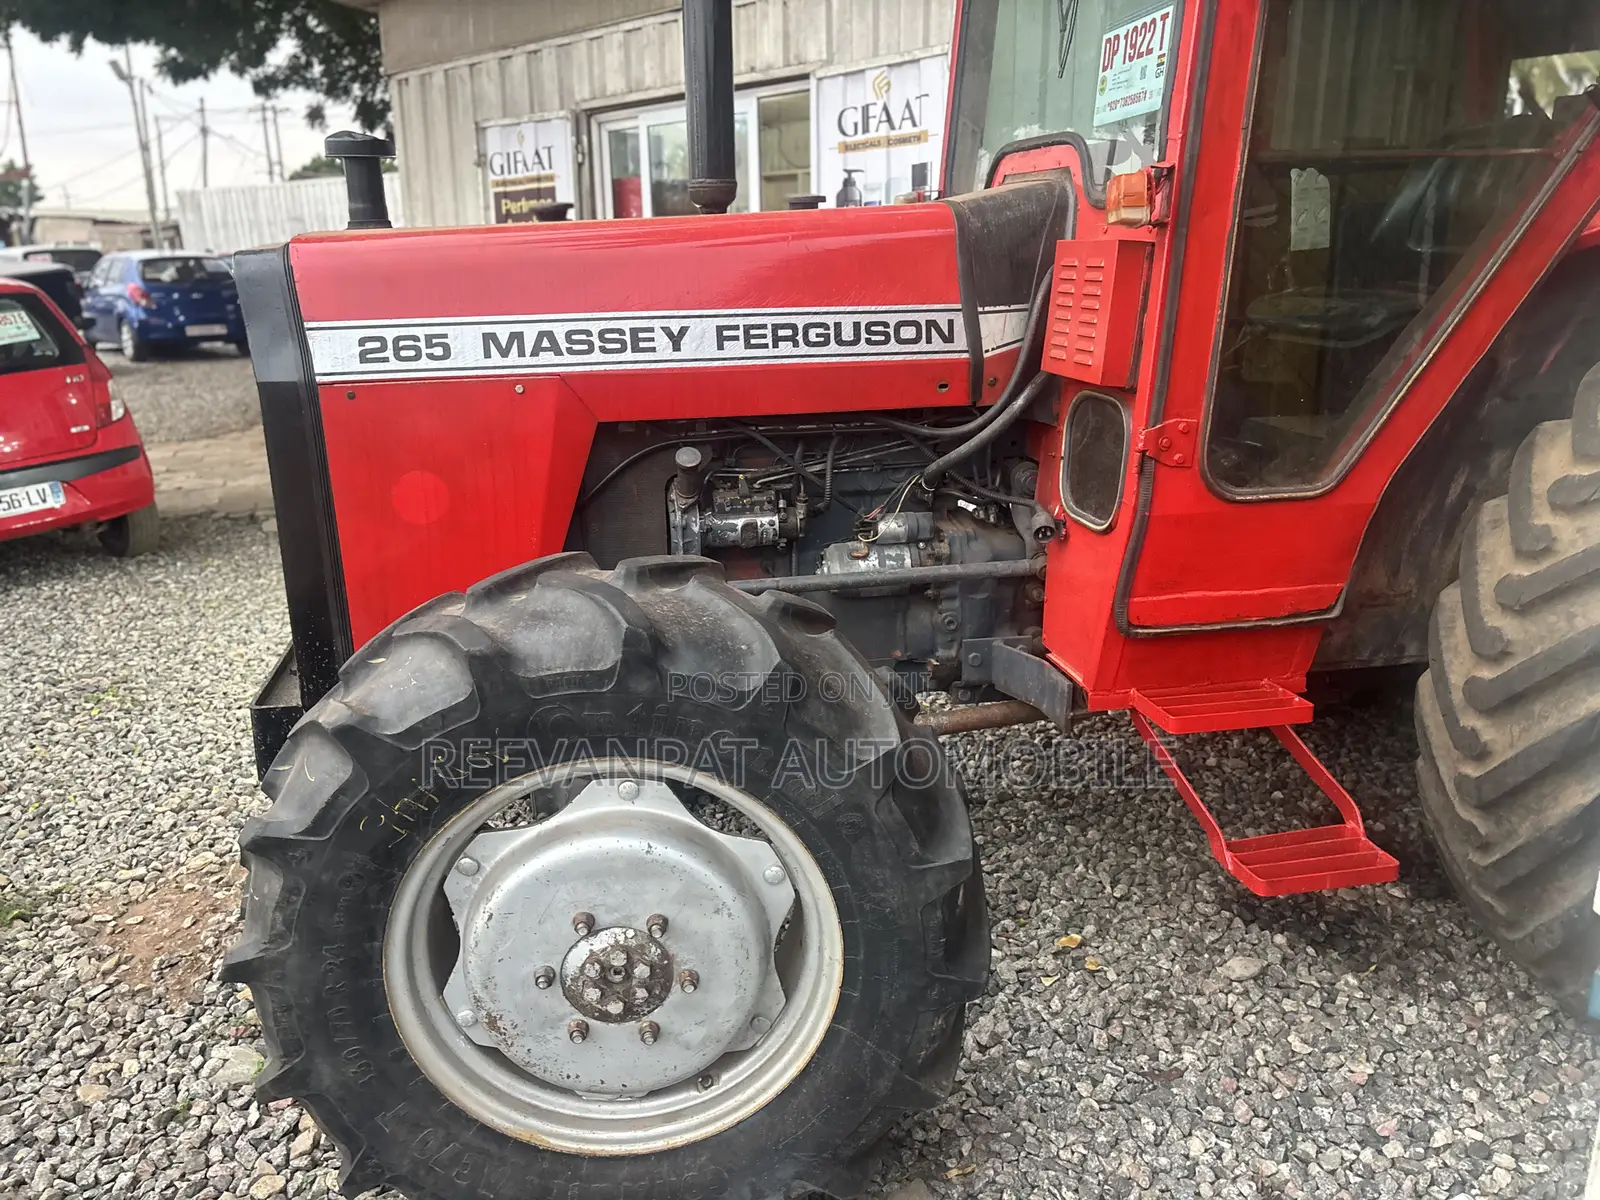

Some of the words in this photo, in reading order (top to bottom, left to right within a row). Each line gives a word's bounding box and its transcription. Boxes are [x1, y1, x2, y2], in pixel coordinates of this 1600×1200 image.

[1102, 33, 1121, 74] DP
[1122, 17, 1157, 66] 1922
[1159, 11, 1170, 51] T
[1155, 66, 1165, 79] GH
[357, 332, 452, 364] 265
[481, 325, 691, 360] MASSEY
[715, 318, 955, 351] FERGUSON
